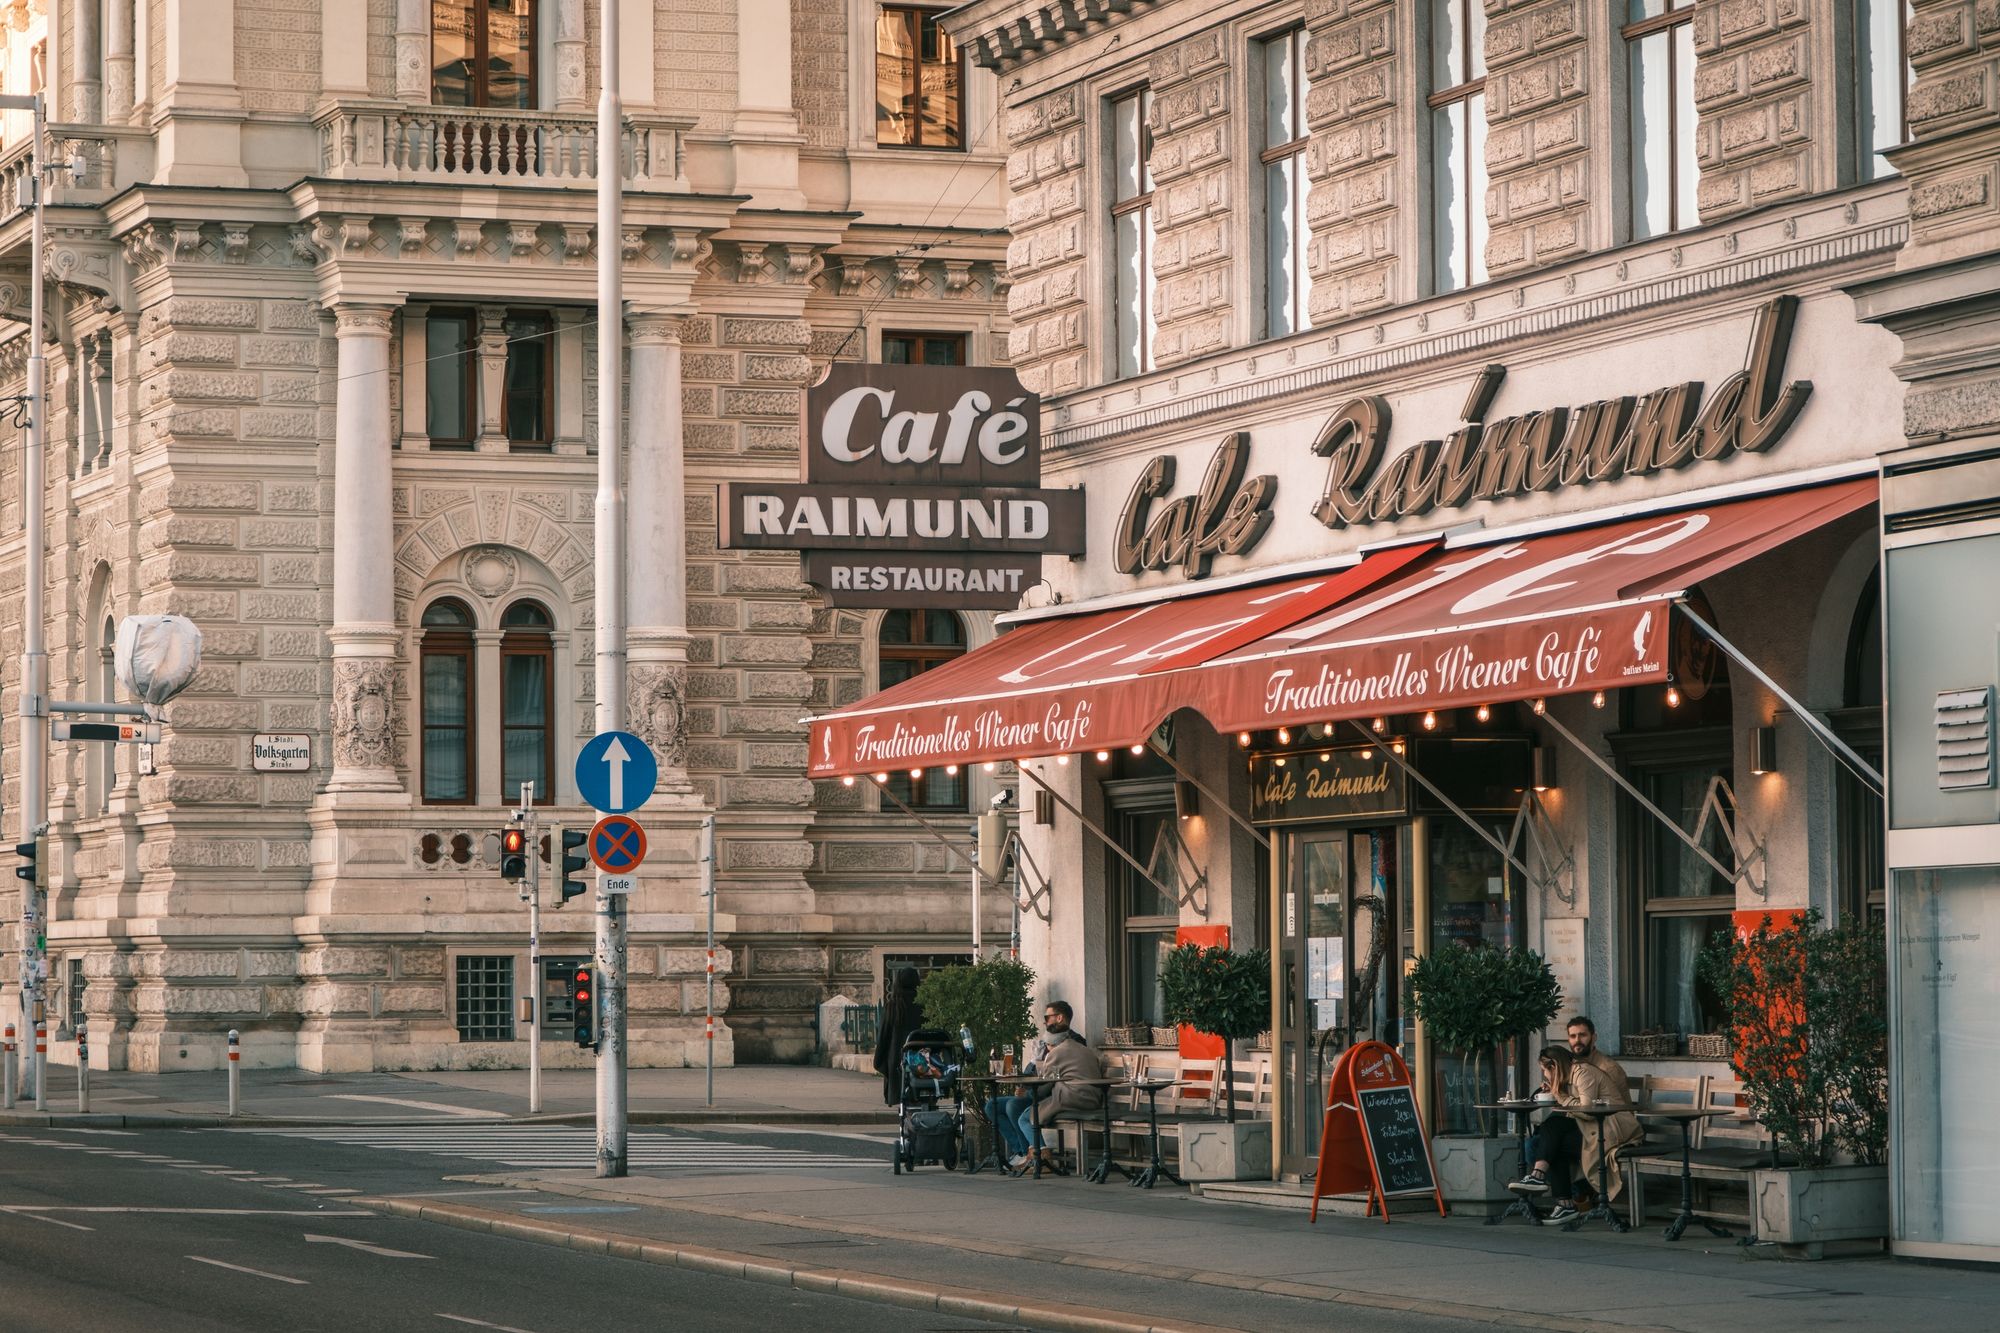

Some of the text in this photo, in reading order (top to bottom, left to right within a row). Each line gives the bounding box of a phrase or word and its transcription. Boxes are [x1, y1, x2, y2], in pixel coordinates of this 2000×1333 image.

[821, 386, 1029, 466] Café
[1113, 294, 1815, 579] Cafe Raimund
[743, 495, 1050, 540] RAIMUND
[831, 565, 1024, 593] RESTAURANT
[1265, 626, 1602, 714] Traditionelles Wiener Café
[1622, 662, 1660, 676] Julius Meinl
[122, 728, 132, 737] U3
[855, 700, 1093, 763] Traditionelles Wiener Café
[254, 744, 309, 762] Volksgarten
[1264, 762, 1390, 804] Cafe Raimund
[607, 879, 630, 889] Ende
